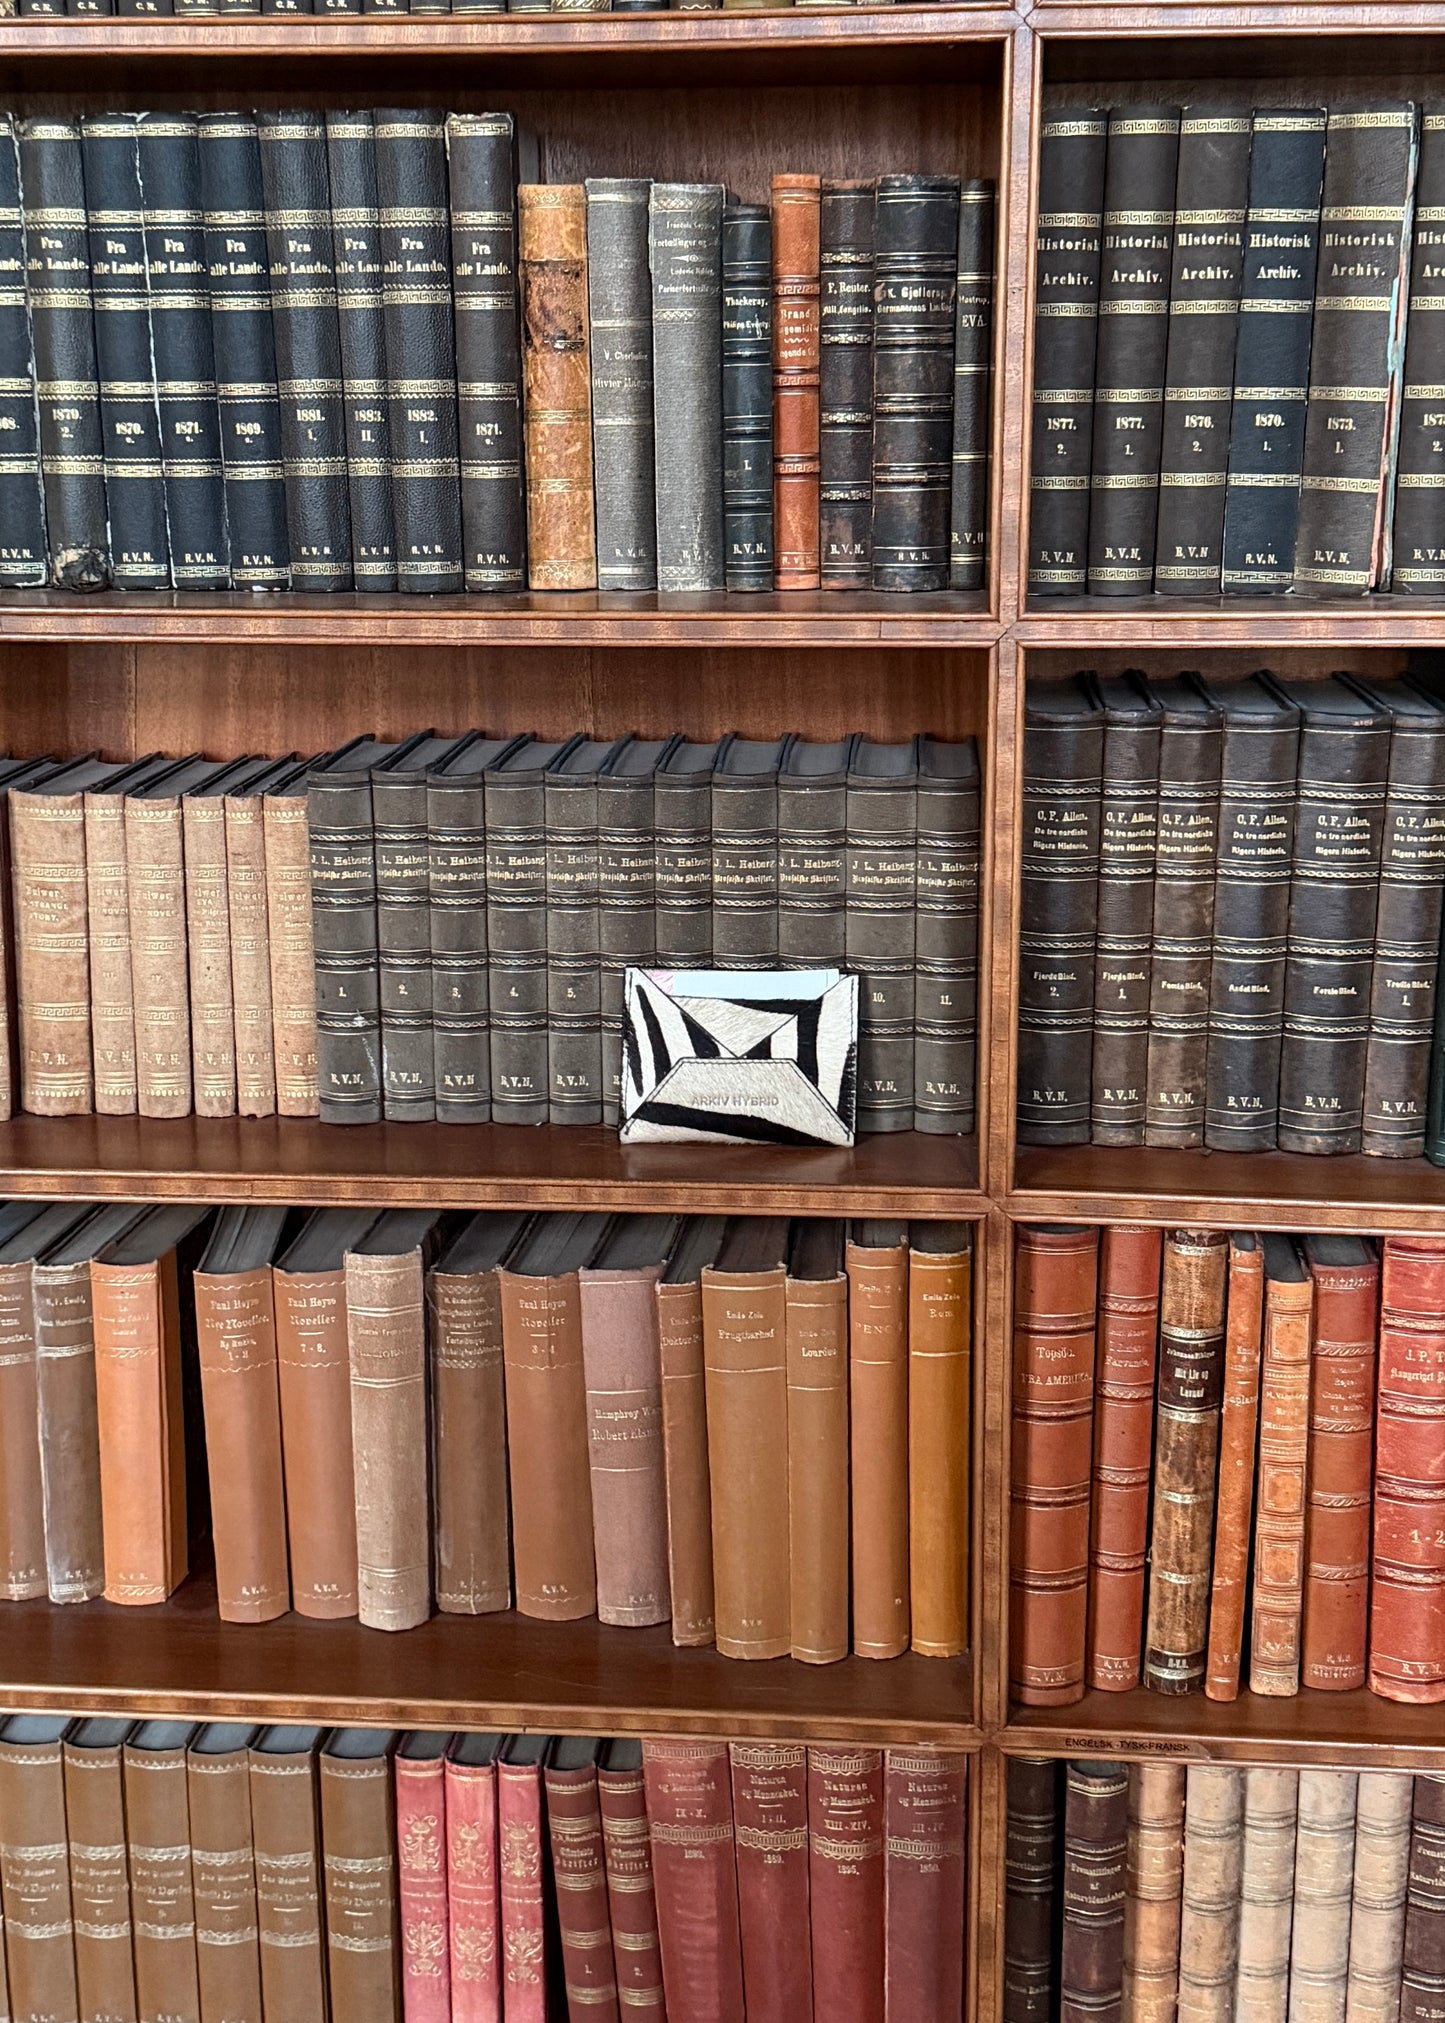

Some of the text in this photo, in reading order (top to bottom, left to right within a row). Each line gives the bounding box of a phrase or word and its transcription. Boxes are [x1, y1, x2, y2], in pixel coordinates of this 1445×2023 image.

[41, 237, 63, 248] Fra
[345, 239, 367, 250] Fra
[401, 238, 424, 250] Fra
[1178, 232, 1240, 246] Historisk
[1249, 234, 1311, 248] Historisk
[1325, 233, 1395, 247] Historisk
[107, 241, 126, 253] Fra
[165, 239, 185, 252] Fra
[227, 240, 246, 253] Fra
[289, 240, 311, 252] Fra
[472, 243, 491, 255] Fra
[47, 258, 89, 270] Lande.
[94, 262, 109, 274] alle
[150, 261, 206, 273] alle Lande.
[210, 263, 266, 276] alle Lande.
[270, 262, 331, 275] alle Lande.
[336, 262, 354, 273] alle
[384, 261, 446, 273] alle Lande.
[457, 262, 511, 275] alle Lande.
[1331, 263, 1385, 277] Archiv.
[1111, 268, 1162, 283] Archiv.
[1181, 266, 1233, 280] Archiv.
[1256, 265, 1301, 279] Archiv.
[1043, 272, 1092, 286] Archiv.
[296, 410, 325, 421] 1881.
[355, 411, 384, 423] 1883.
[408, 410, 438, 421] 1882.
[1047, 417, 1076, 431] 1877.
[1115, 417, 1145, 430] 1877.
[691, 1095, 779, 1107] ARKIV HYBRID
